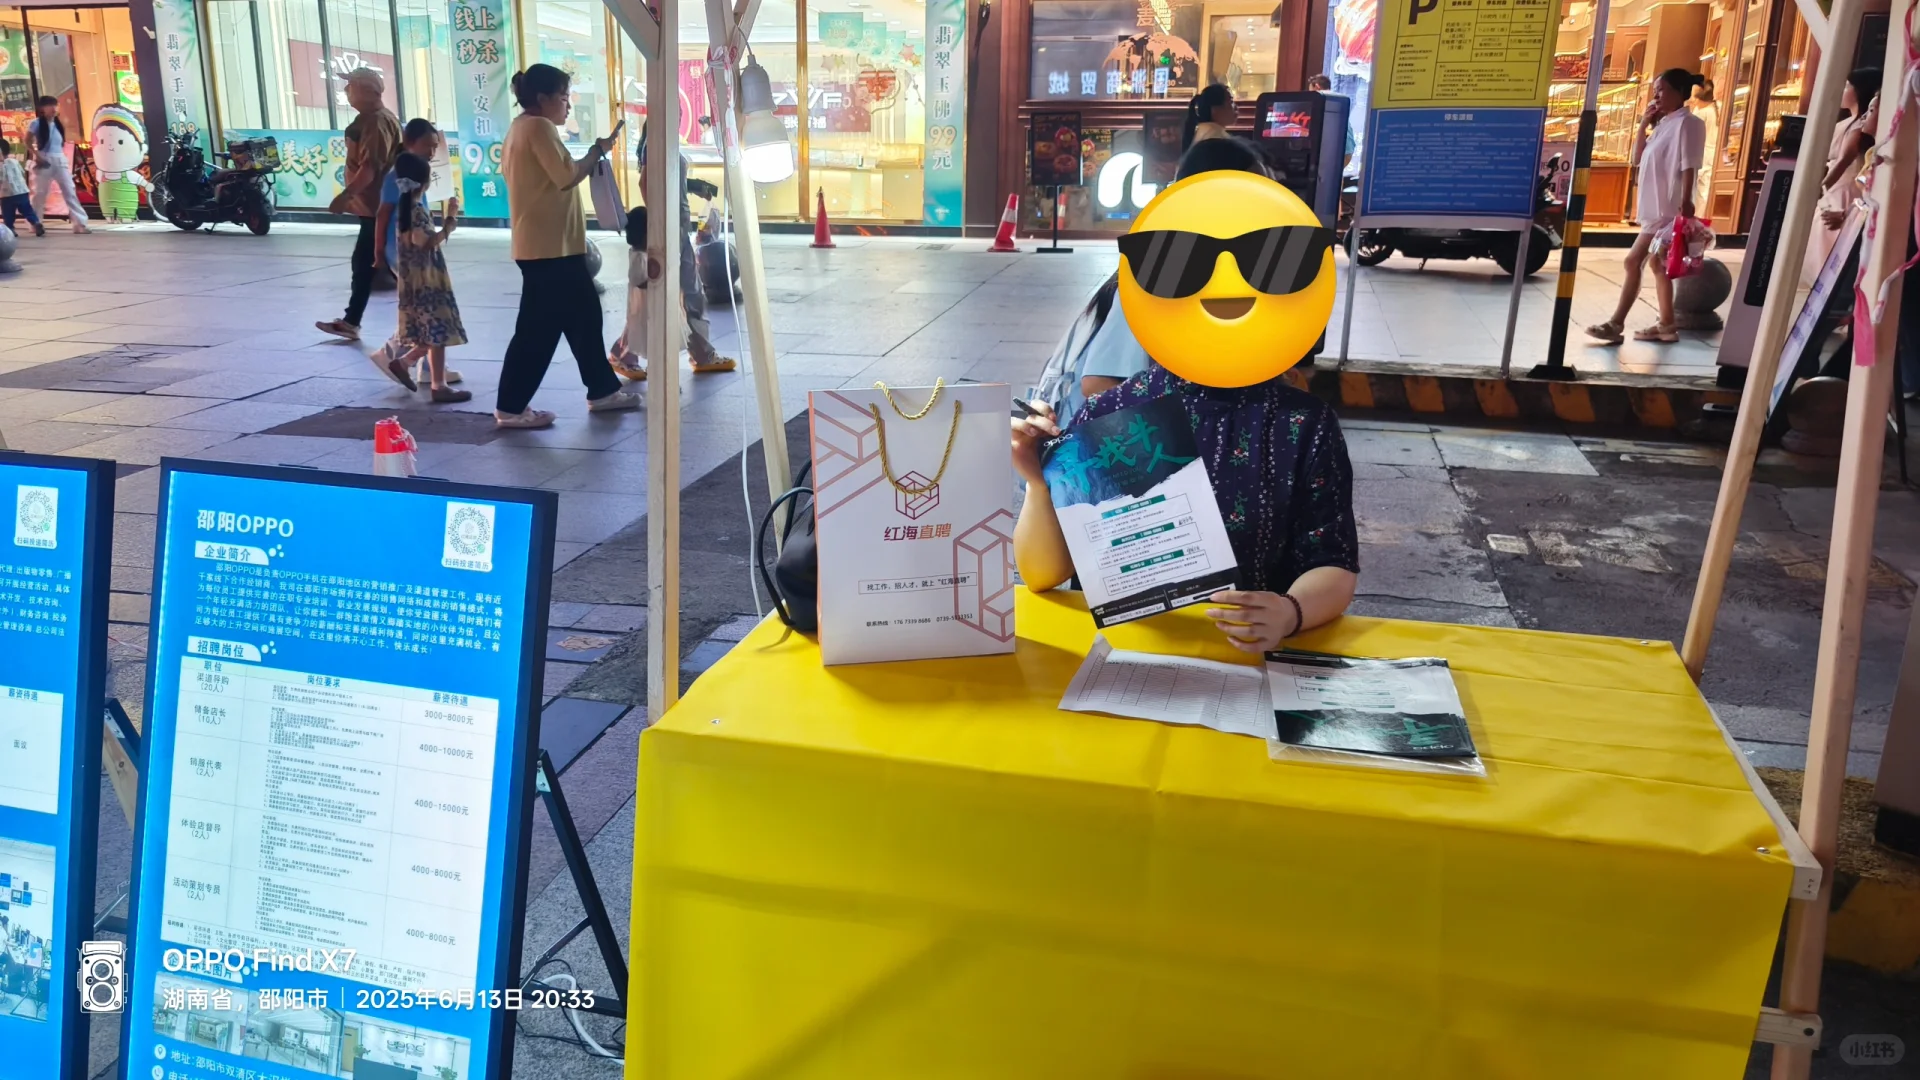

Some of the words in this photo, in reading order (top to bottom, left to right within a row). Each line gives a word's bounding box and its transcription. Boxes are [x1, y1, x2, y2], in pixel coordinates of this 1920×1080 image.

[455, 6, 497, 31] 线上
[456, 39, 499, 64] 秒杀
[167, 33, 187, 114] 翡翠手镯
[934, 25, 951, 118] 翡翠玉佛
[473, 72, 491, 134] 平安扣
[784, 115, 827, 129] 张福
[929, 125, 957, 147] 99
[933, 151, 951, 169] 元
[482, 181, 497, 197] 元
[196, 508, 294, 538] 邵阳OPPO
[884, 523, 952, 542] 红海直聘
[204, 544, 252, 562] 企业简介
[445, 558, 489, 570] 扫码投递简历
[197, 640, 245, 659] 招聘岗位
[196, 672, 230, 686] 渠道导购
[424, 709, 475, 726] 3000-8000元
[307, 675, 341, 688] 岗位要求
[433, 691, 469, 707] 薪资待遇
[195, 704, 226, 718] 储备店长
[419, 743, 474, 760] 4000-10000元
[414, 798, 470, 816] 4000-15000元
[411, 863, 462, 882] 4000-8000元
[172, 876, 221, 896] 活动策划专员
[406, 927, 457, 946] 4000-8000元
